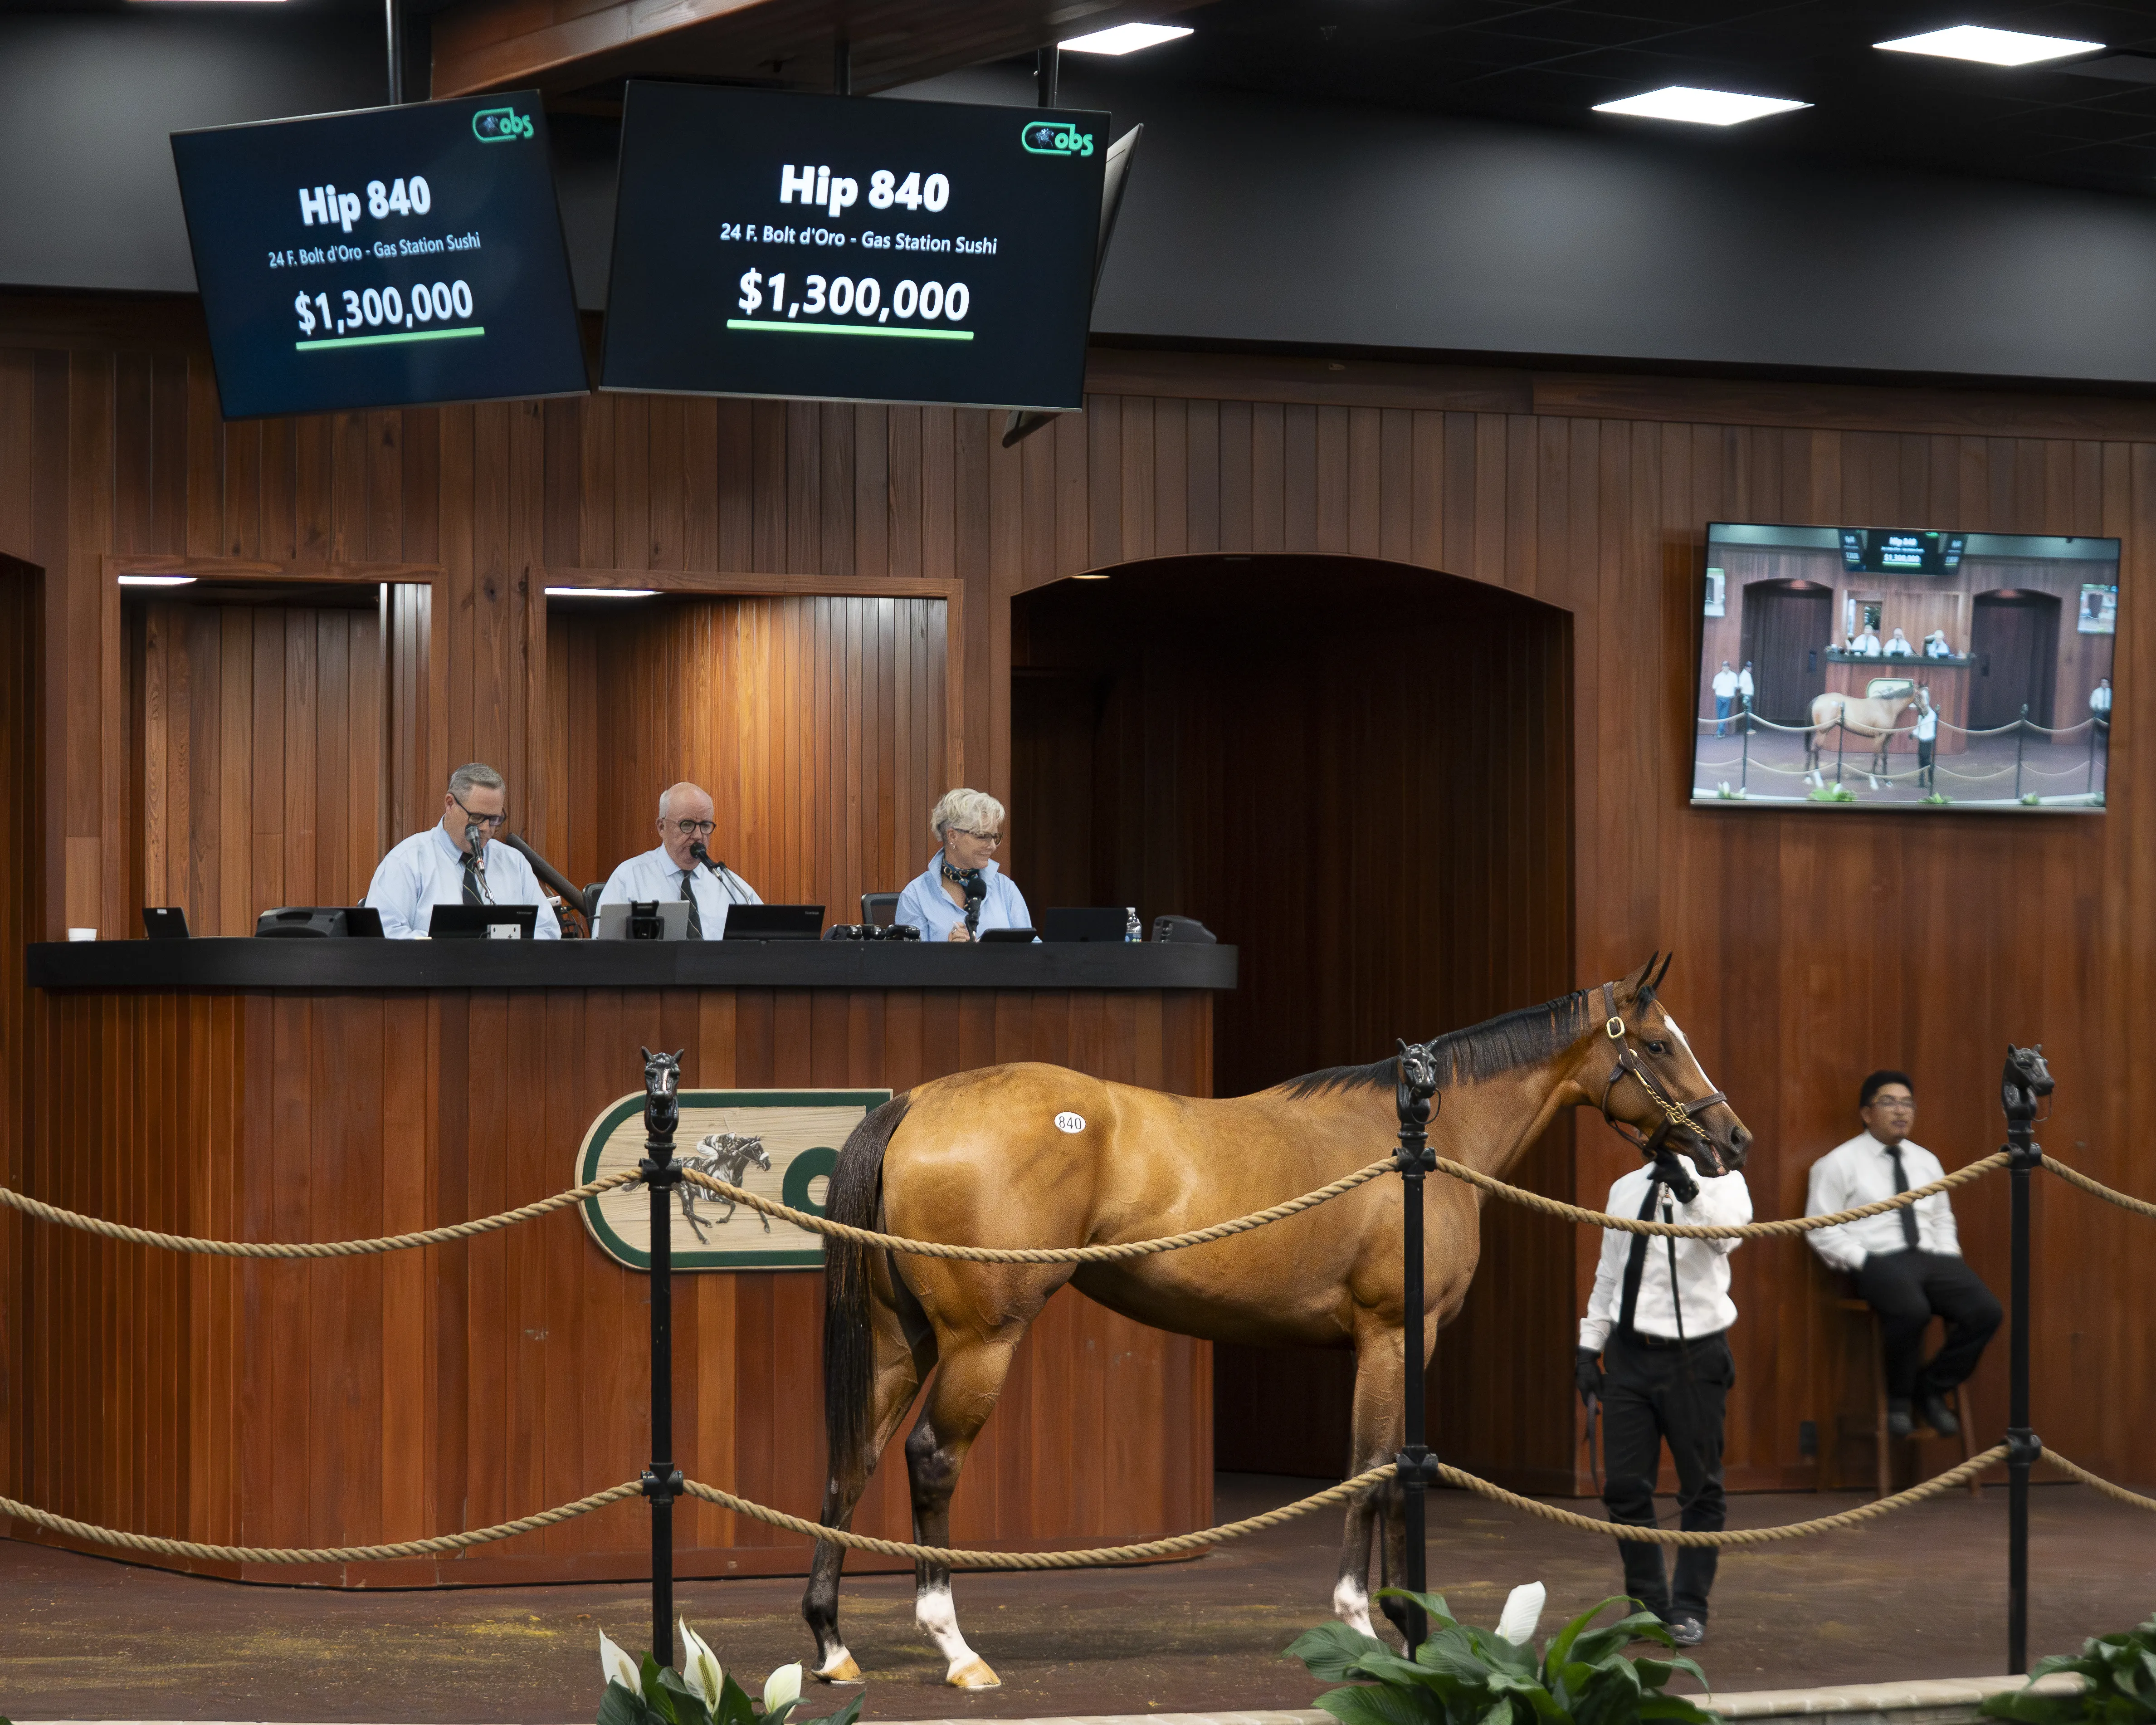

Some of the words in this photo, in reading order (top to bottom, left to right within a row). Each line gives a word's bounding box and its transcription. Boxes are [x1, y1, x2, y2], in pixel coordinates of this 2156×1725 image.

[299, 184, 361, 233] Hip
[366, 176, 431, 219] 840
[780, 165, 858, 217] Hip
[868, 170, 949, 212] 840
[268, 251, 285, 268] 24
[286, 250, 298, 266] F.
[299, 247, 325, 265] Bolt
[327, 245, 362, 263] d'Oro
[373, 241, 397, 258] Gas
[399, 236, 444, 256] Station
[446, 231, 481, 252] Sushi
[720, 223, 741, 241] 24
[746, 224, 757, 242] F.
[763, 225, 796, 244] Bolt
[800, 227, 845, 246] d'Oro
[862, 231, 891, 249] Gas
[895, 233, 951, 252] Station
[955, 236, 997, 254] Sushi
[295, 280, 473, 336] $1,300,000
[739, 268, 969, 323] $1,300,000
[1059, 1116, 1082, 1129] 840
